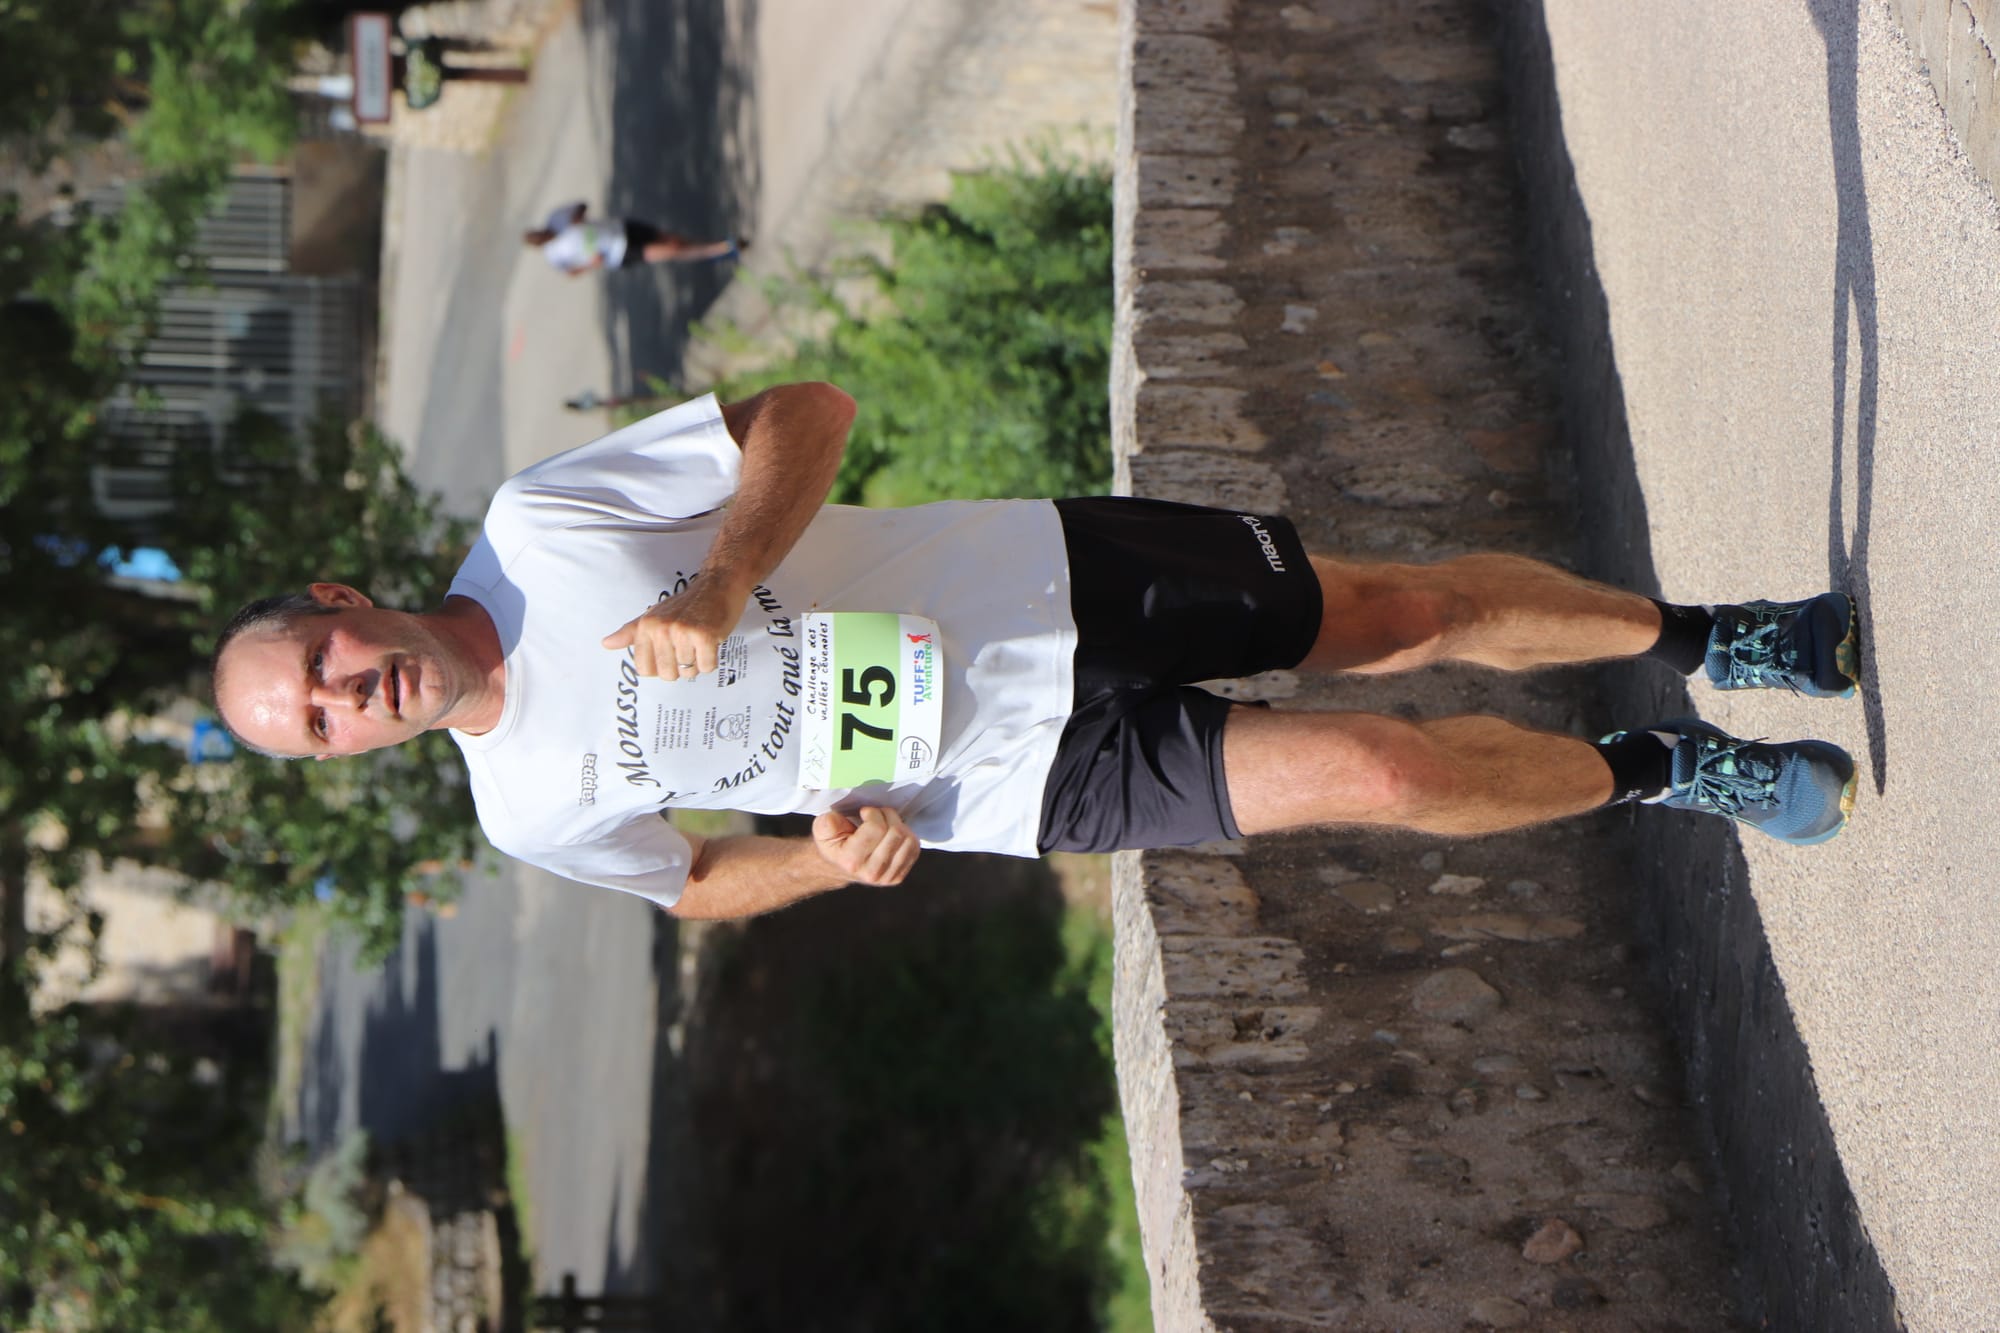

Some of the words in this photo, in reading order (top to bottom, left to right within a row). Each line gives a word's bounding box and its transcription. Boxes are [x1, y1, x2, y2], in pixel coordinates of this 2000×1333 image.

[766, 616, 794, 637] la
[808, 628, 816, 648] des
[818, 622, 828, 674] cévenoles
[773, 645, 802, 696] qué
[806, 656, 820, 714] Challenge
[914, 649, 924, 706] TUFF'S
[922, 643, 932, 700] Aventure
[616, 645, 661, 788] Moussa
[818, 681, 828, 720] vallées
[840, 666, 896, 750] 75
[762, 700, 795, 760] tout
[909, 741, 922, 769] BFP
